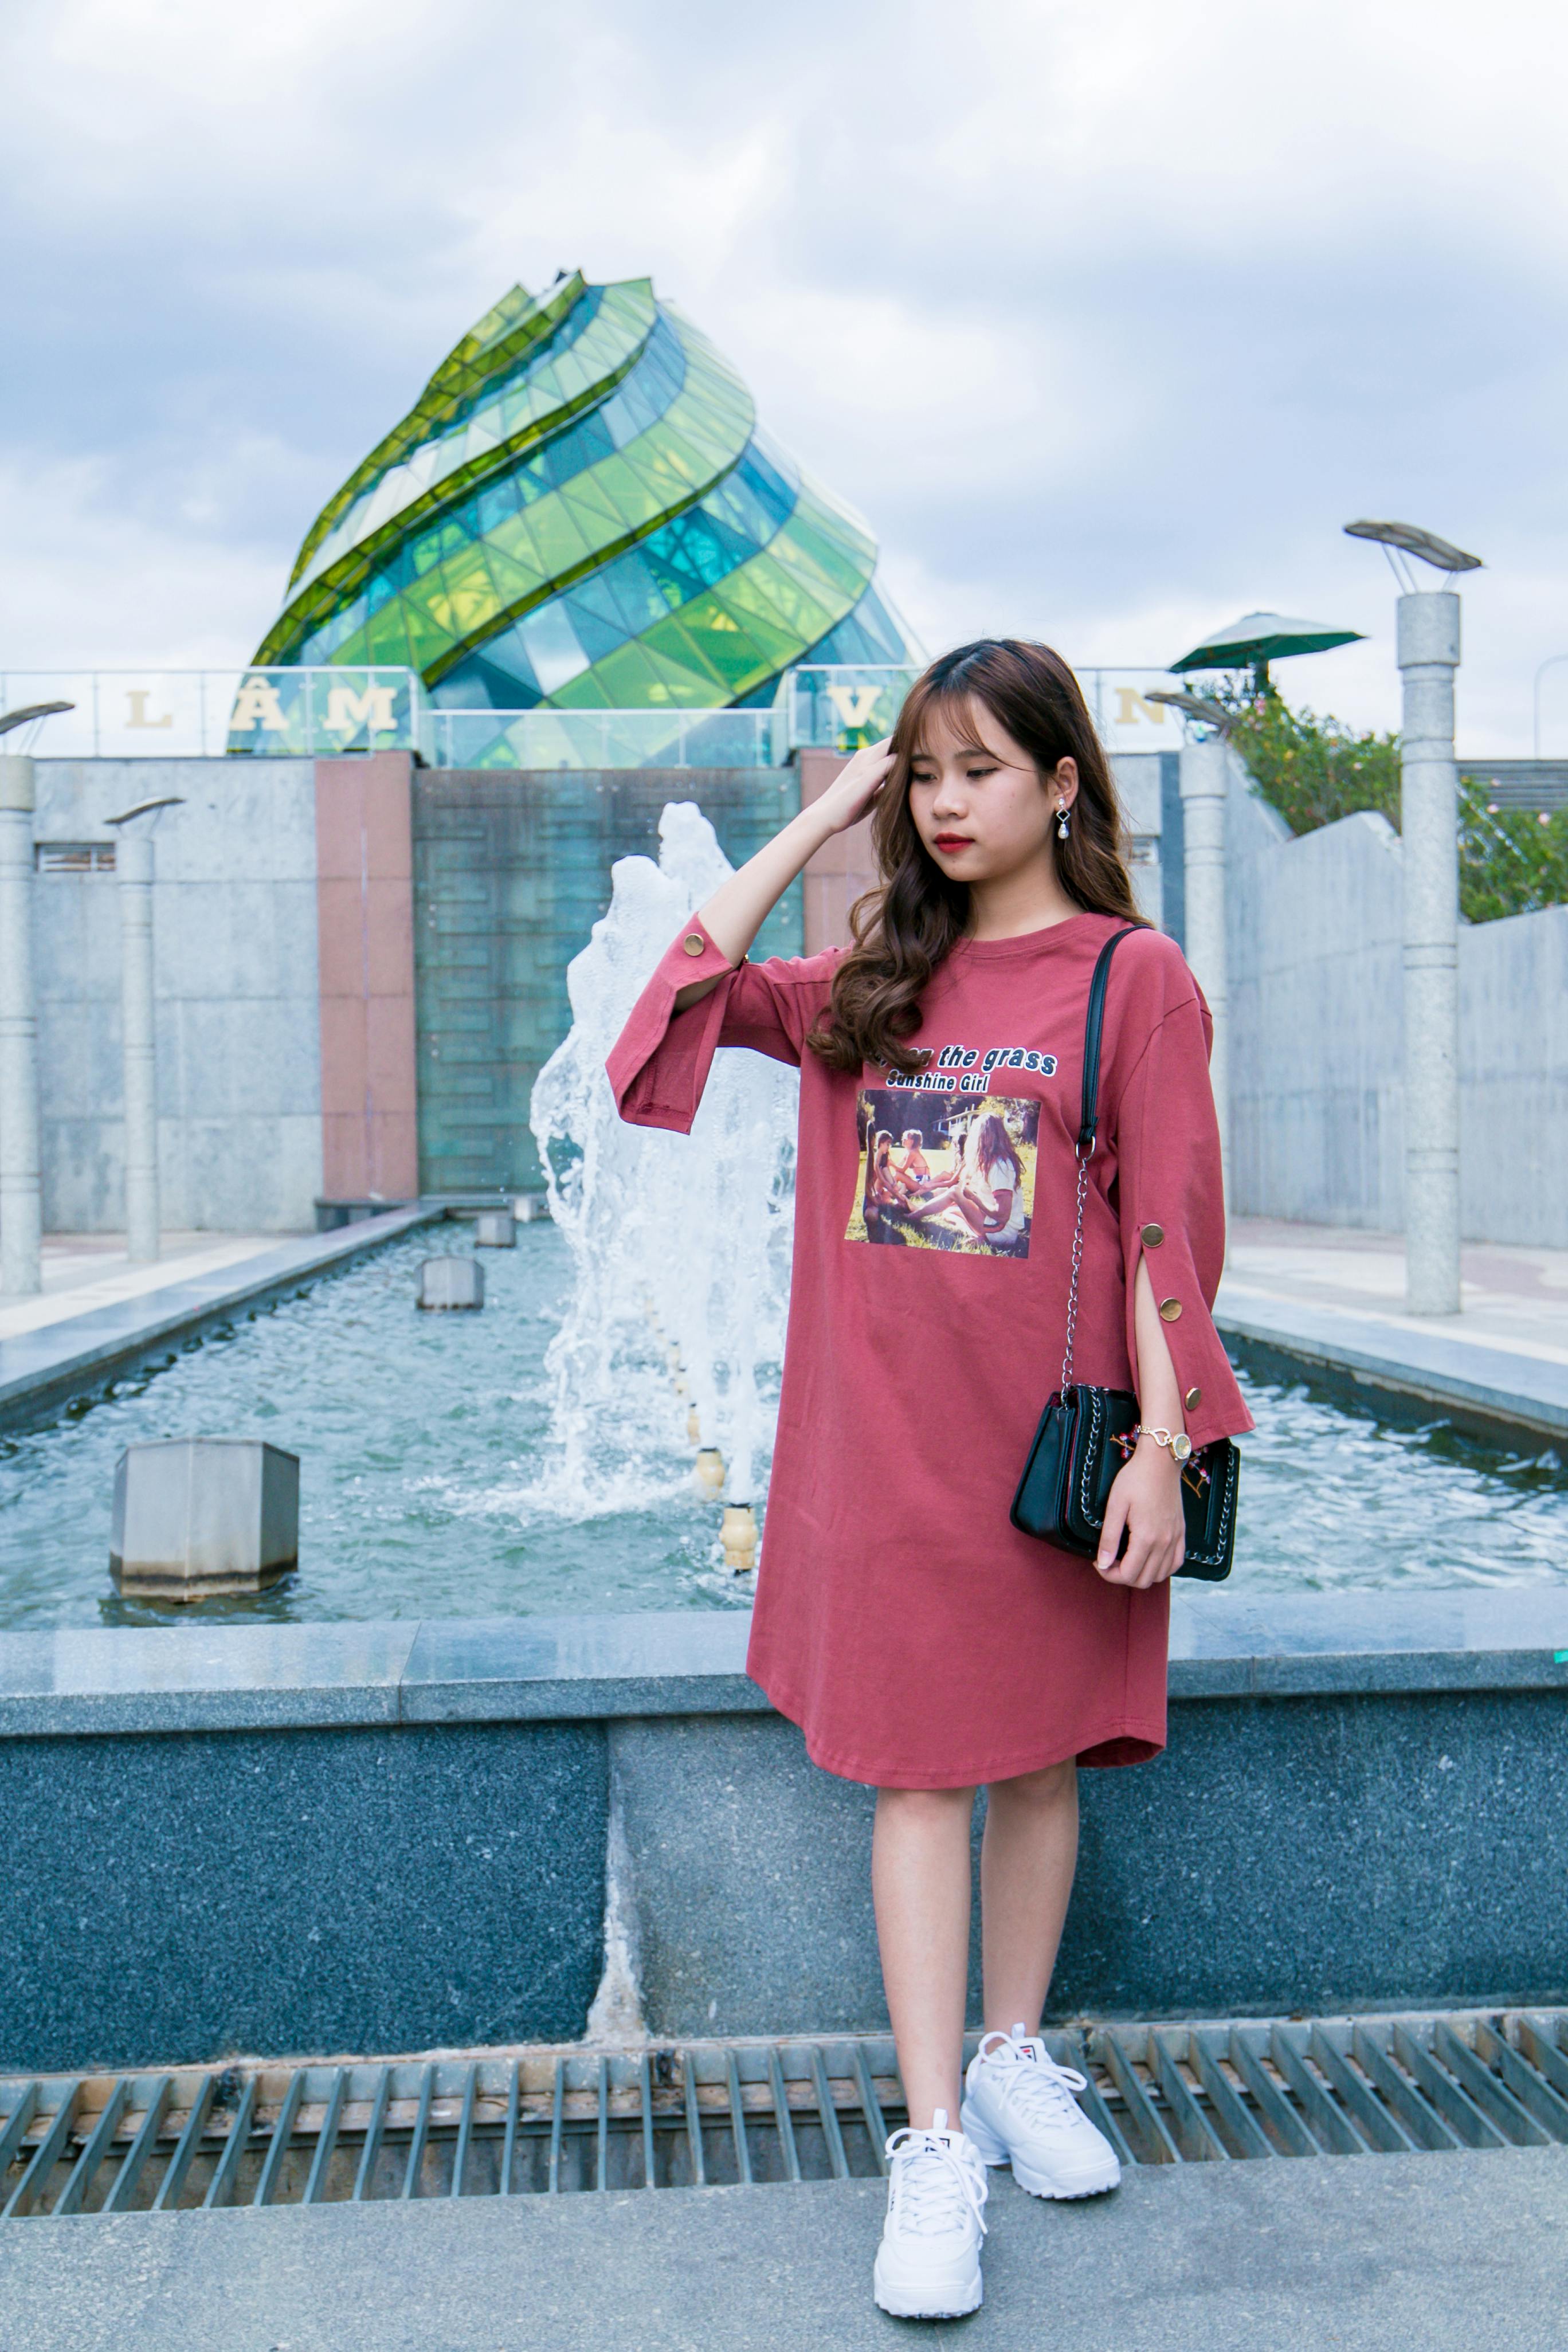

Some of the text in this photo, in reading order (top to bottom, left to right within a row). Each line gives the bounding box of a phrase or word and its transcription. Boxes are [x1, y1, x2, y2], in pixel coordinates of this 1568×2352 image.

[125, 676, 398, 731] LÂM
[938, 1046, 978, 1067] the
[982, 1048, 1057, 1076] grass
[887, 1070, 990, 1092] Sunshine Girl
